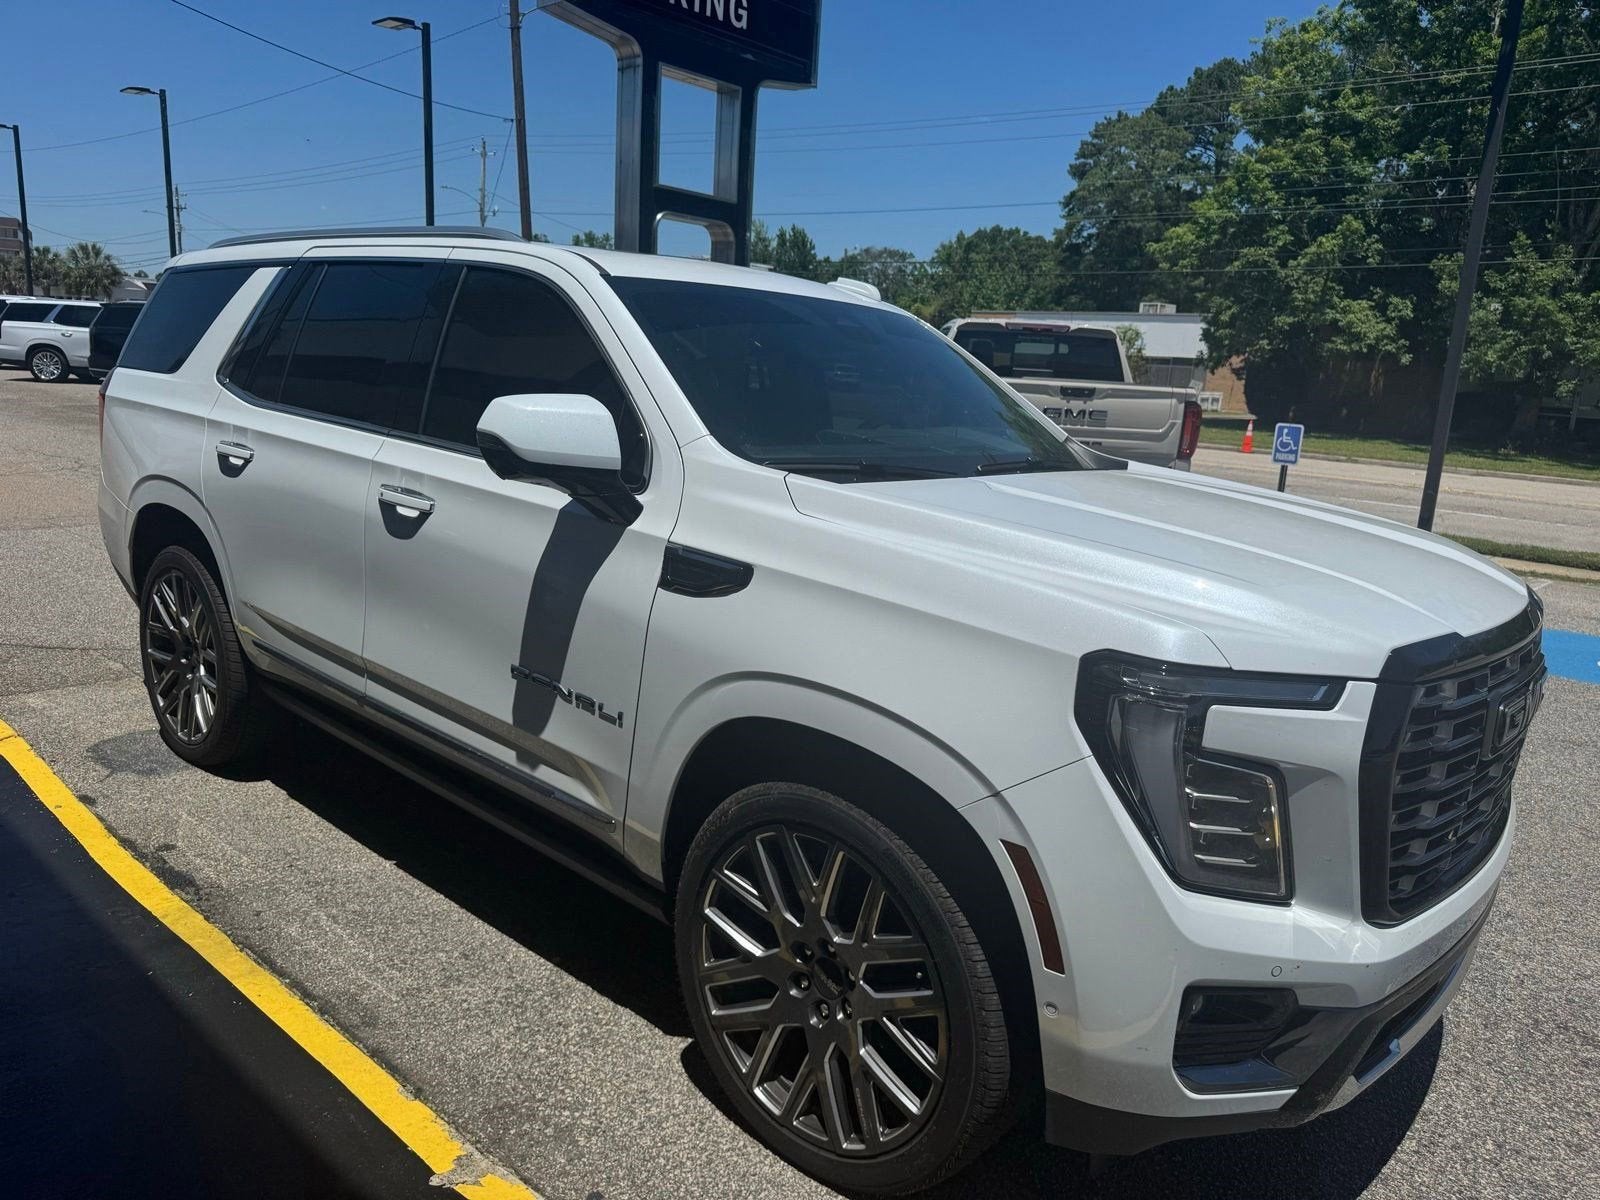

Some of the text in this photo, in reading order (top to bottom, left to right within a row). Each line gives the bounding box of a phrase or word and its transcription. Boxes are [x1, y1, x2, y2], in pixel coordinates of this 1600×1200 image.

[668, 0, 748, 30] NG
[1042, 407, 1108, 421] GMC
[1275, 452, 1297, 462] PARKING
[510, 664, 624, 726] DENALI
